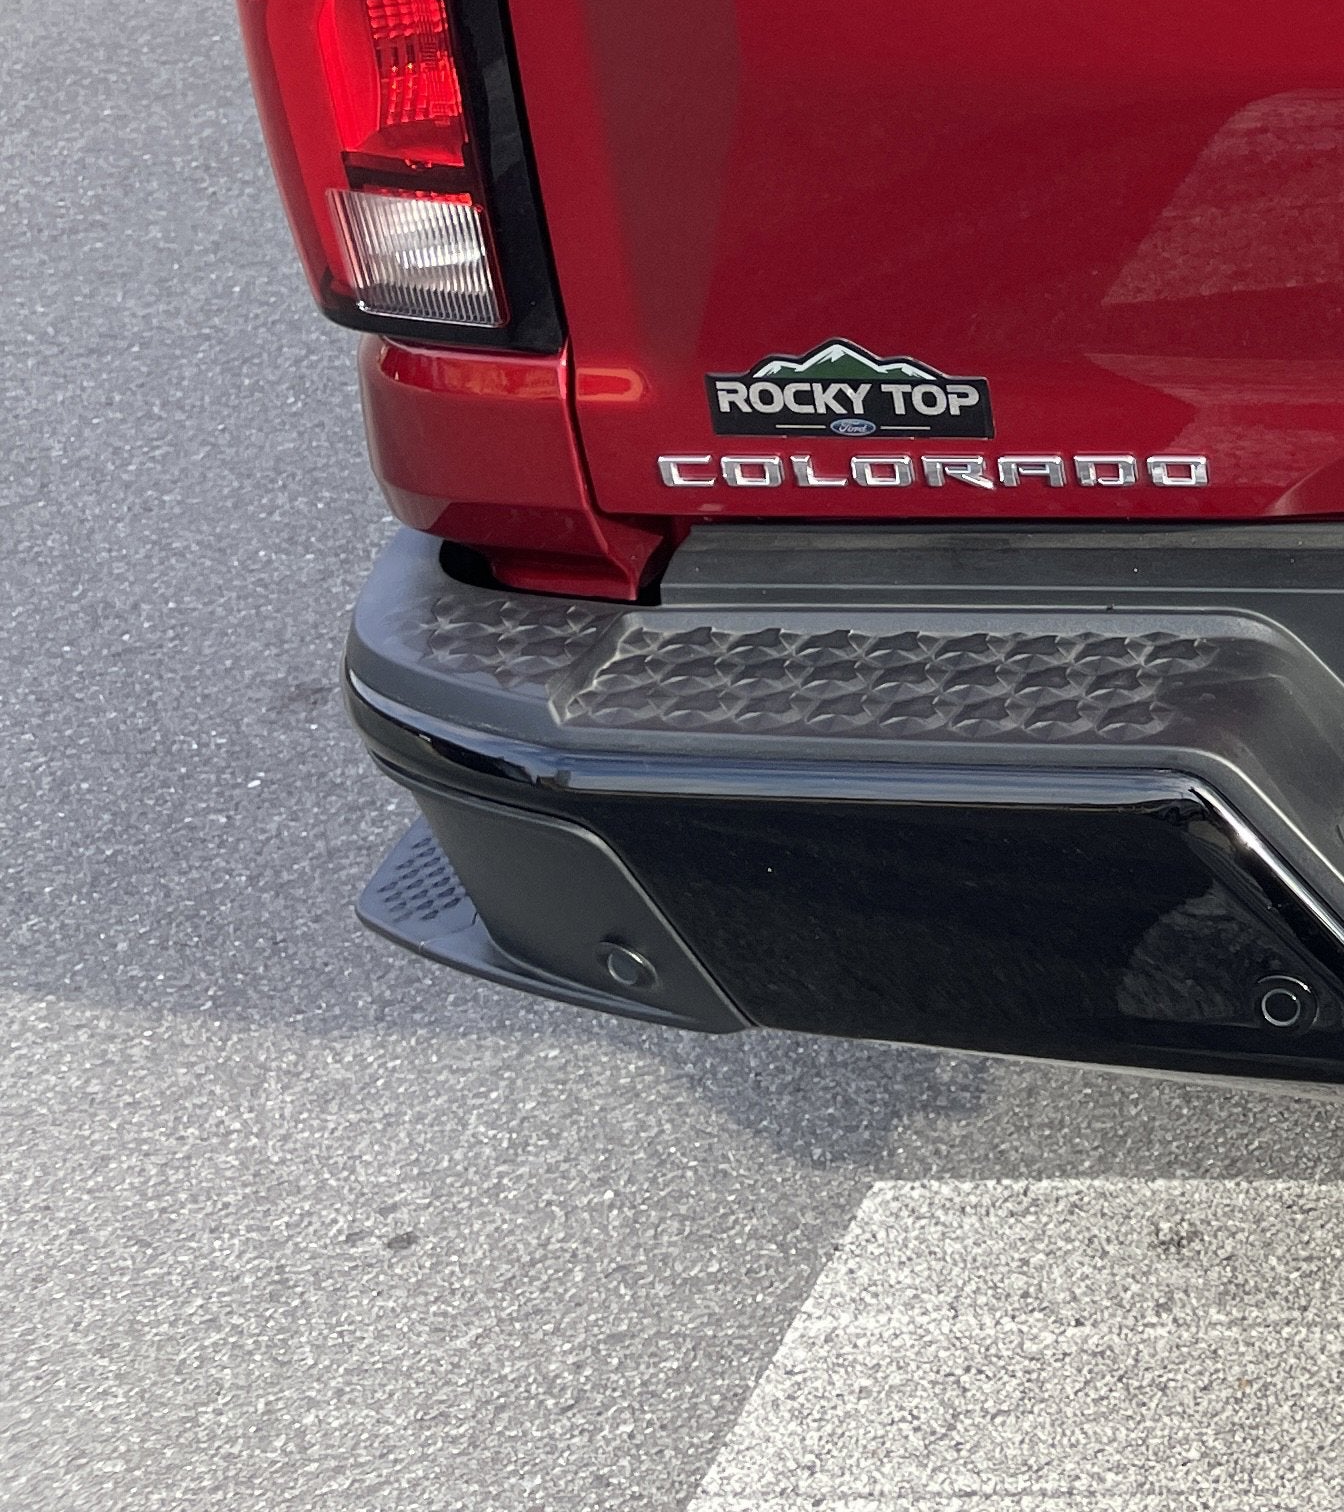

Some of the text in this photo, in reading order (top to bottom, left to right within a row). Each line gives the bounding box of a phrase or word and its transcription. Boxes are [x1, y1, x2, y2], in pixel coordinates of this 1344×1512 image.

[715, 381, 980, 416] ROCKY TOP
[838, 420, 869, 434] Ford
[657, 453, 1210, 488] COLORADO
